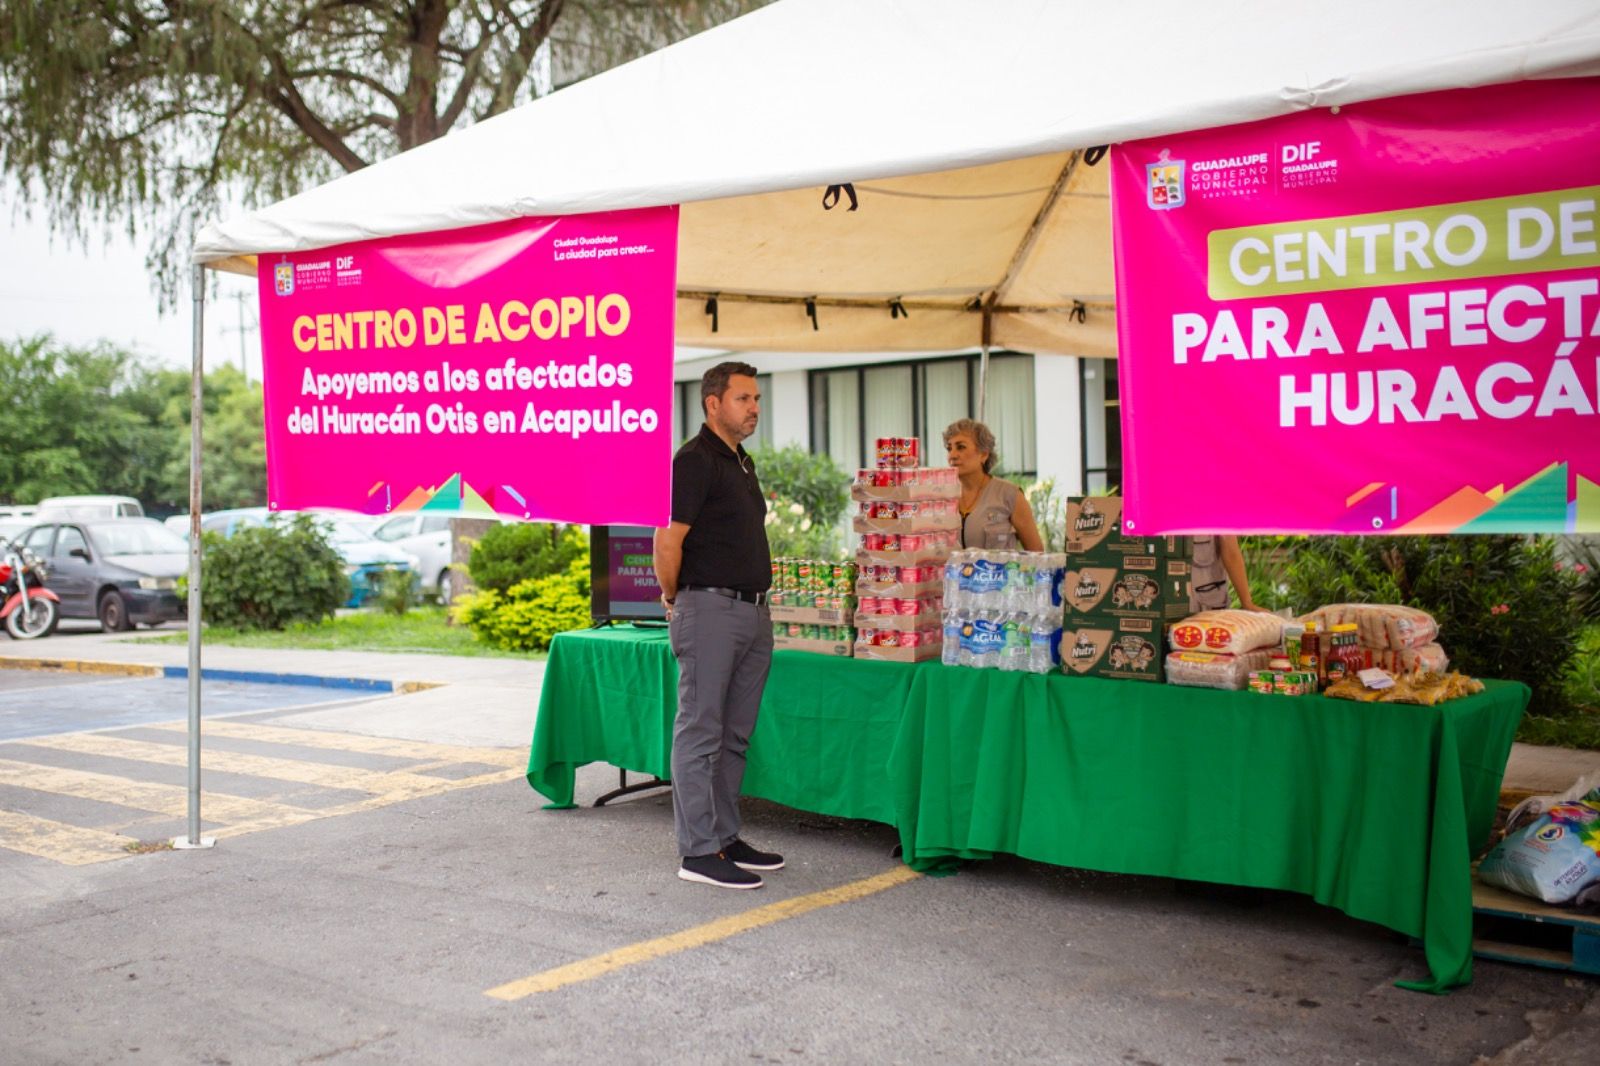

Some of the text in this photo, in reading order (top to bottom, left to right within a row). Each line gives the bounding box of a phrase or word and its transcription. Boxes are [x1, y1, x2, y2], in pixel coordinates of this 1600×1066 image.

[1282, 141, 1321, 164] DIF
[1191, 153, 1268, 172] GUADALUPE
[1282, 160, 1337, 174] GUADALUPE
[1191, 165, 1268, 182] GOBIERNO
[1282, 168, 1337, 183] GOBIERNO
[1191, 175, 1267, 191] MUNICIPAL
[1283, 176, 1337, 189] MUNICIPAL
[553, 239, 579, 247] Ciudad
[1229, 200, 1597, 286] CENTRO DE
[554, 251, 565, 261] La
[565, 247, 596, 259] ciudad
[597, 248, 618, 259] para
[336, 256, 354, 270] DIF
[292, 293, 631, 352] CENTRO DE ACOPIO
[1172, 279, 1600, 364] PARA AFECT
[302, 355, 633, 400] Apoyemos a los afectados
[1279, 342, 1600, 427] HURACÁ
[288, 400, 659, 439] del Huracán Otis en Acapulco
[1075, 514, 1104, 530] Nutri
[618, 567, 644, 575] PARA
[972, 573, 1004, 583] AGUA
[1074, 583, 1100, 597] Nutri
[1072, 644, 1096, 658] Nutri
